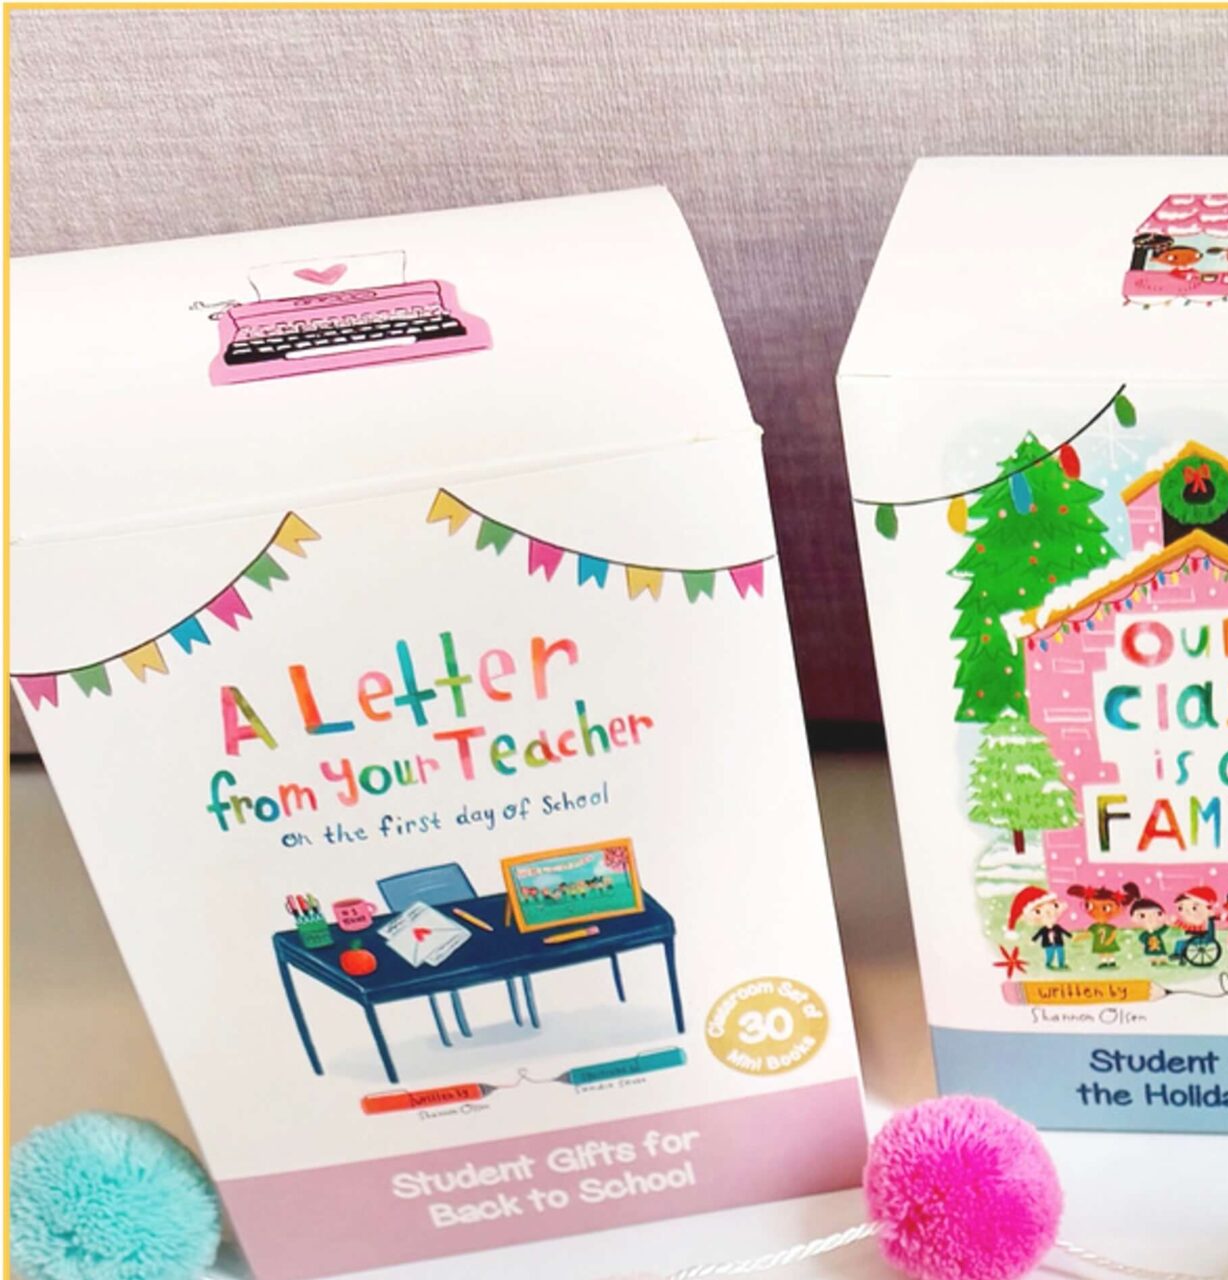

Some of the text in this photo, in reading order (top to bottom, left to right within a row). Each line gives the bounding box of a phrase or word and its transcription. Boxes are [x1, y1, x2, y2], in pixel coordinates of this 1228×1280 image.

[221, 631, 579, 756] A Letter
[206, 769, 318, 832] from
[433, 699, 655, 781] Teacher
[1155, 748, 1194, 786] is
[281, 780, 610, 848] on the first day of School
[1037, 984, 1129, 1000] written by
[737, 1007, 795, 1044] 30
[1099, 1007, 1148, 1025] Olsen
[1089, 1049, 1219, 1075] Student
[1076, 1083, 1133, 1106] the
[391, 1129, 701, 1200] Student Gifts for
[428, 1162, 697, 1229] Back to School
